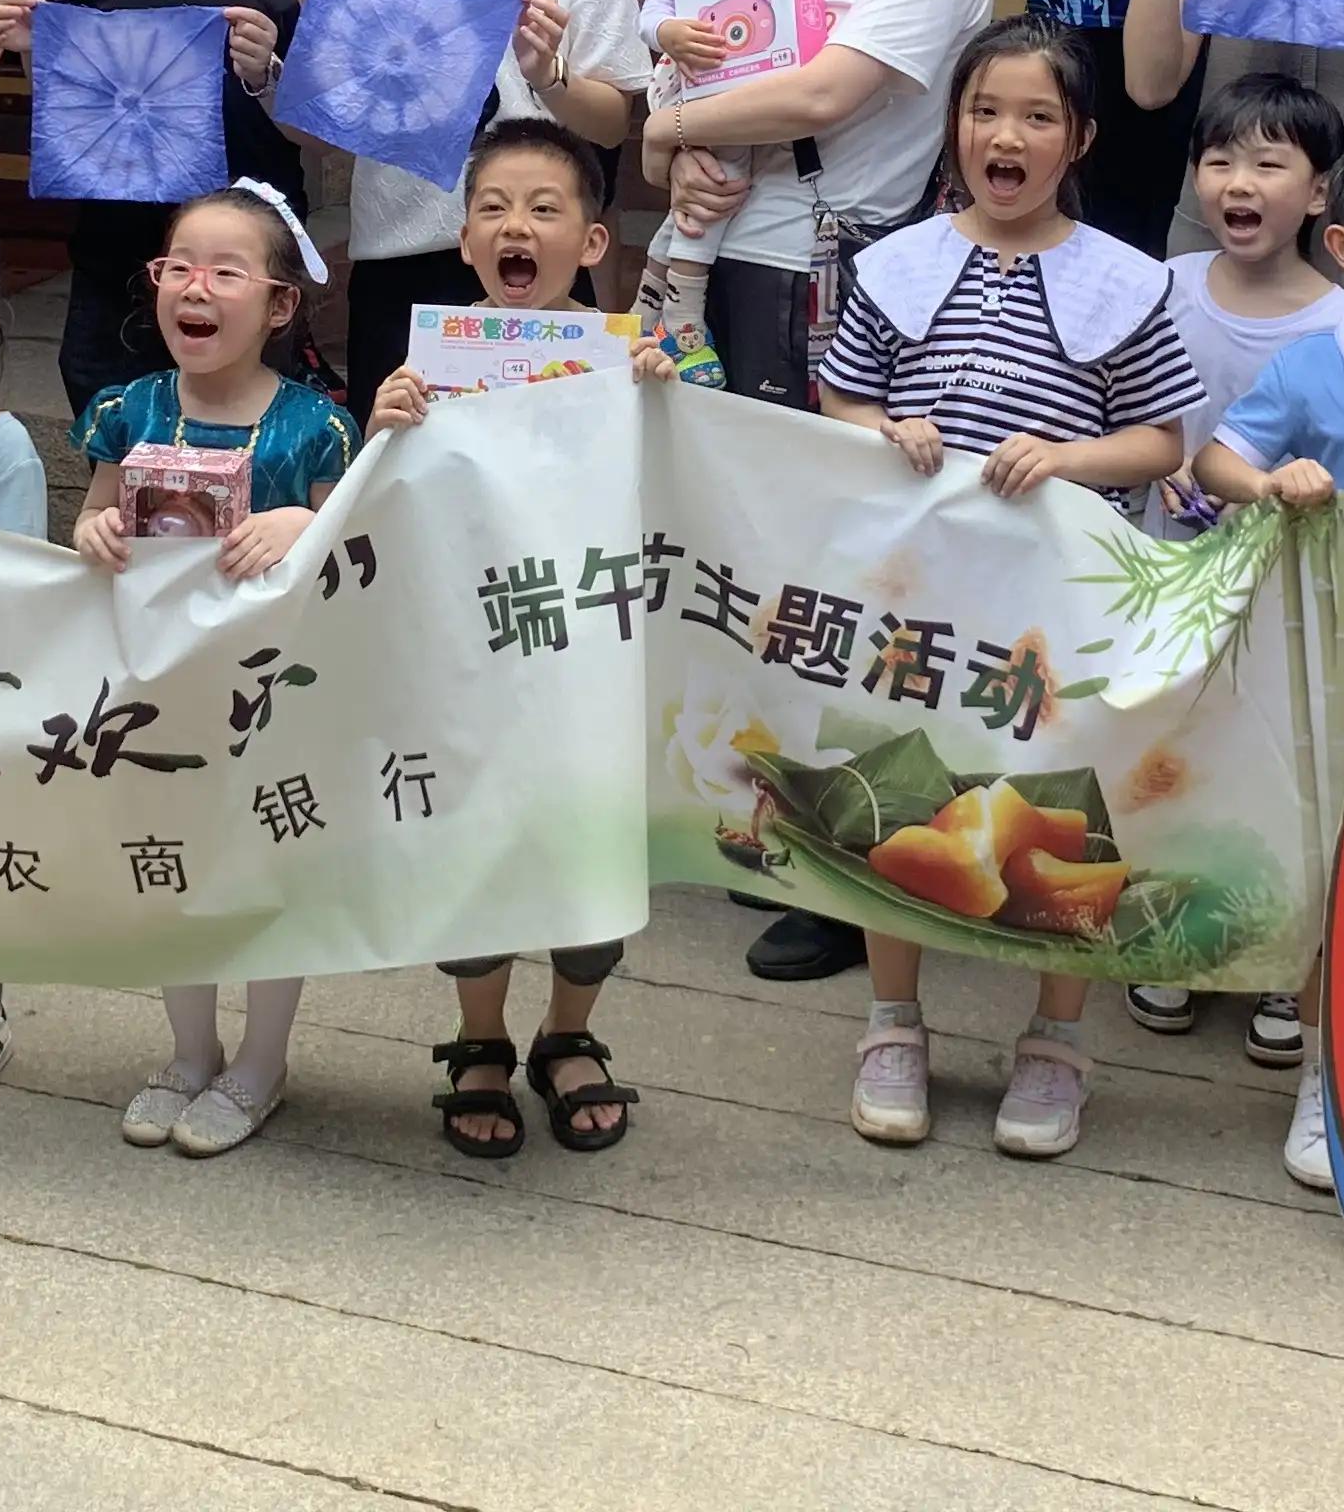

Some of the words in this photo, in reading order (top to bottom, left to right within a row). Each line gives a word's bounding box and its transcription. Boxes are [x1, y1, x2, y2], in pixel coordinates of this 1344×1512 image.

[442, 315, 562, 343] 益智管道积木
[476, 530, 1047, 741] 端午节主题活动
